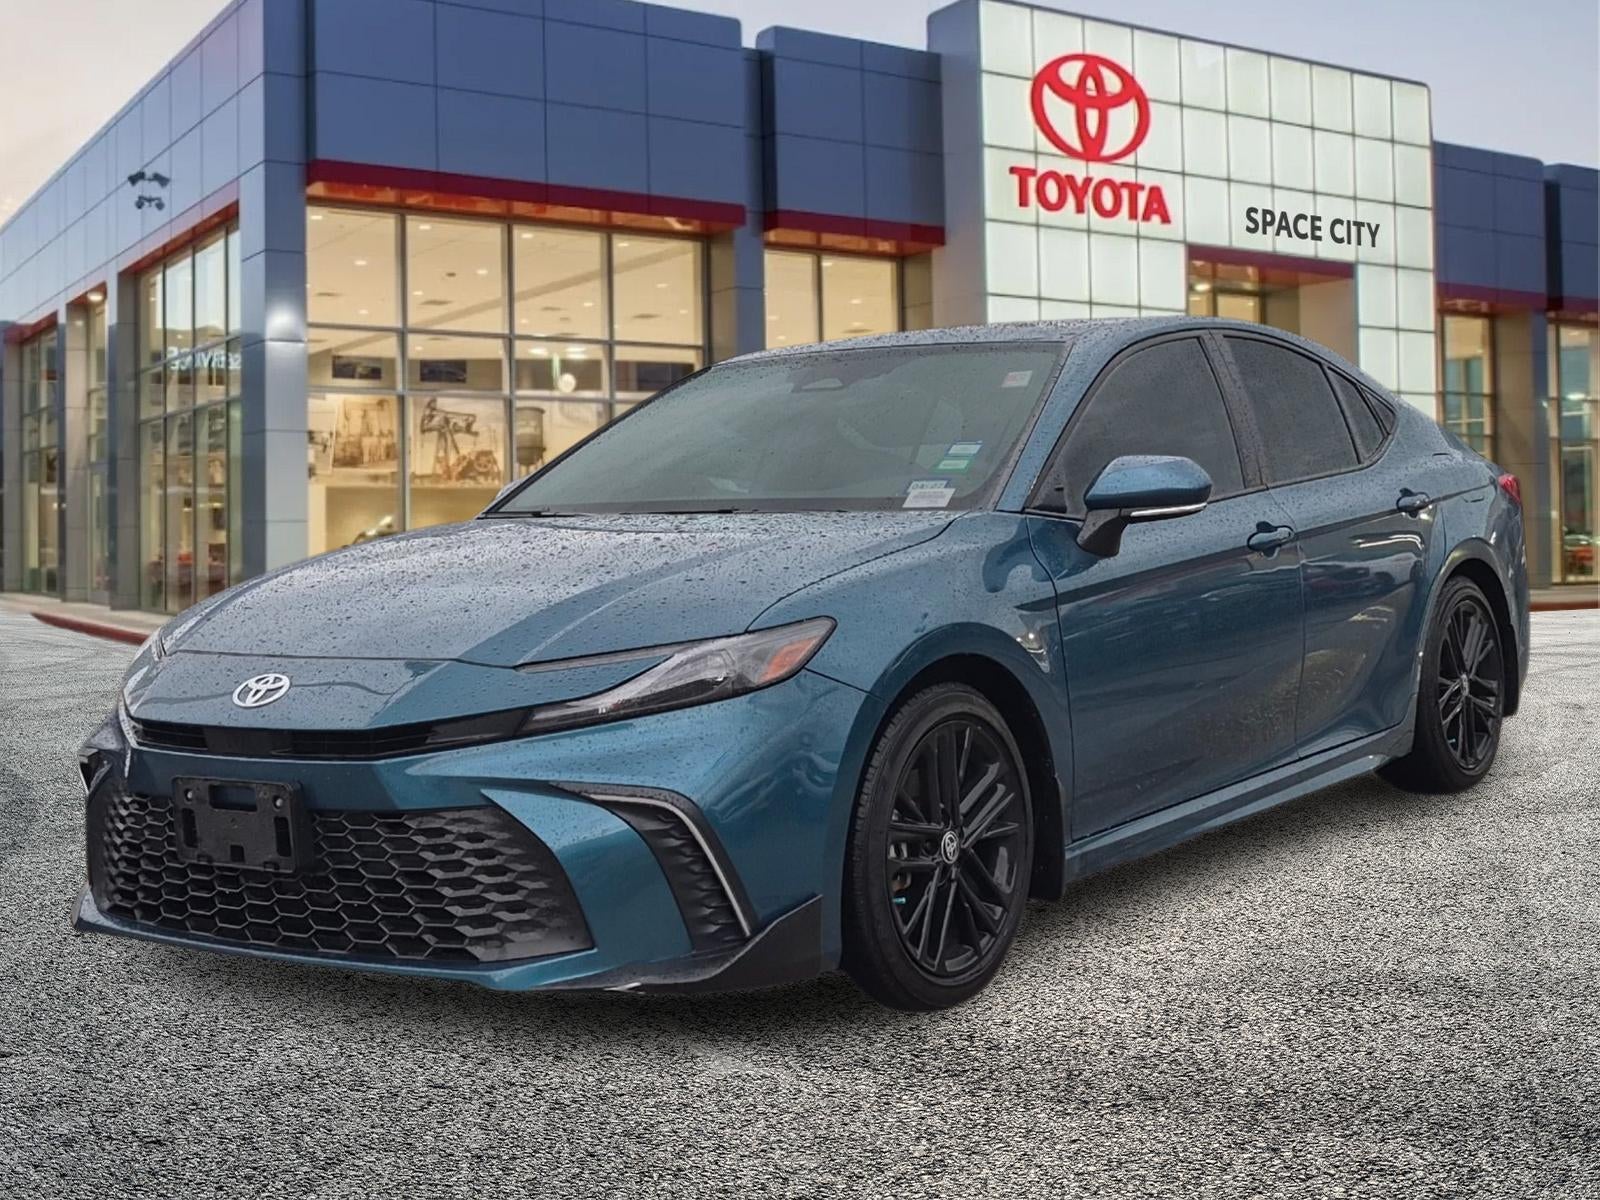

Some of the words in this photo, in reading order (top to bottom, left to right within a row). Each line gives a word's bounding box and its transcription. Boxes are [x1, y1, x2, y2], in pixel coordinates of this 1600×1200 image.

[1009, 166, 1171, 225] TOYOTA
[1245, 206, 1322, 242] SPACE
[1329, 218, 1380, 248] CITY
